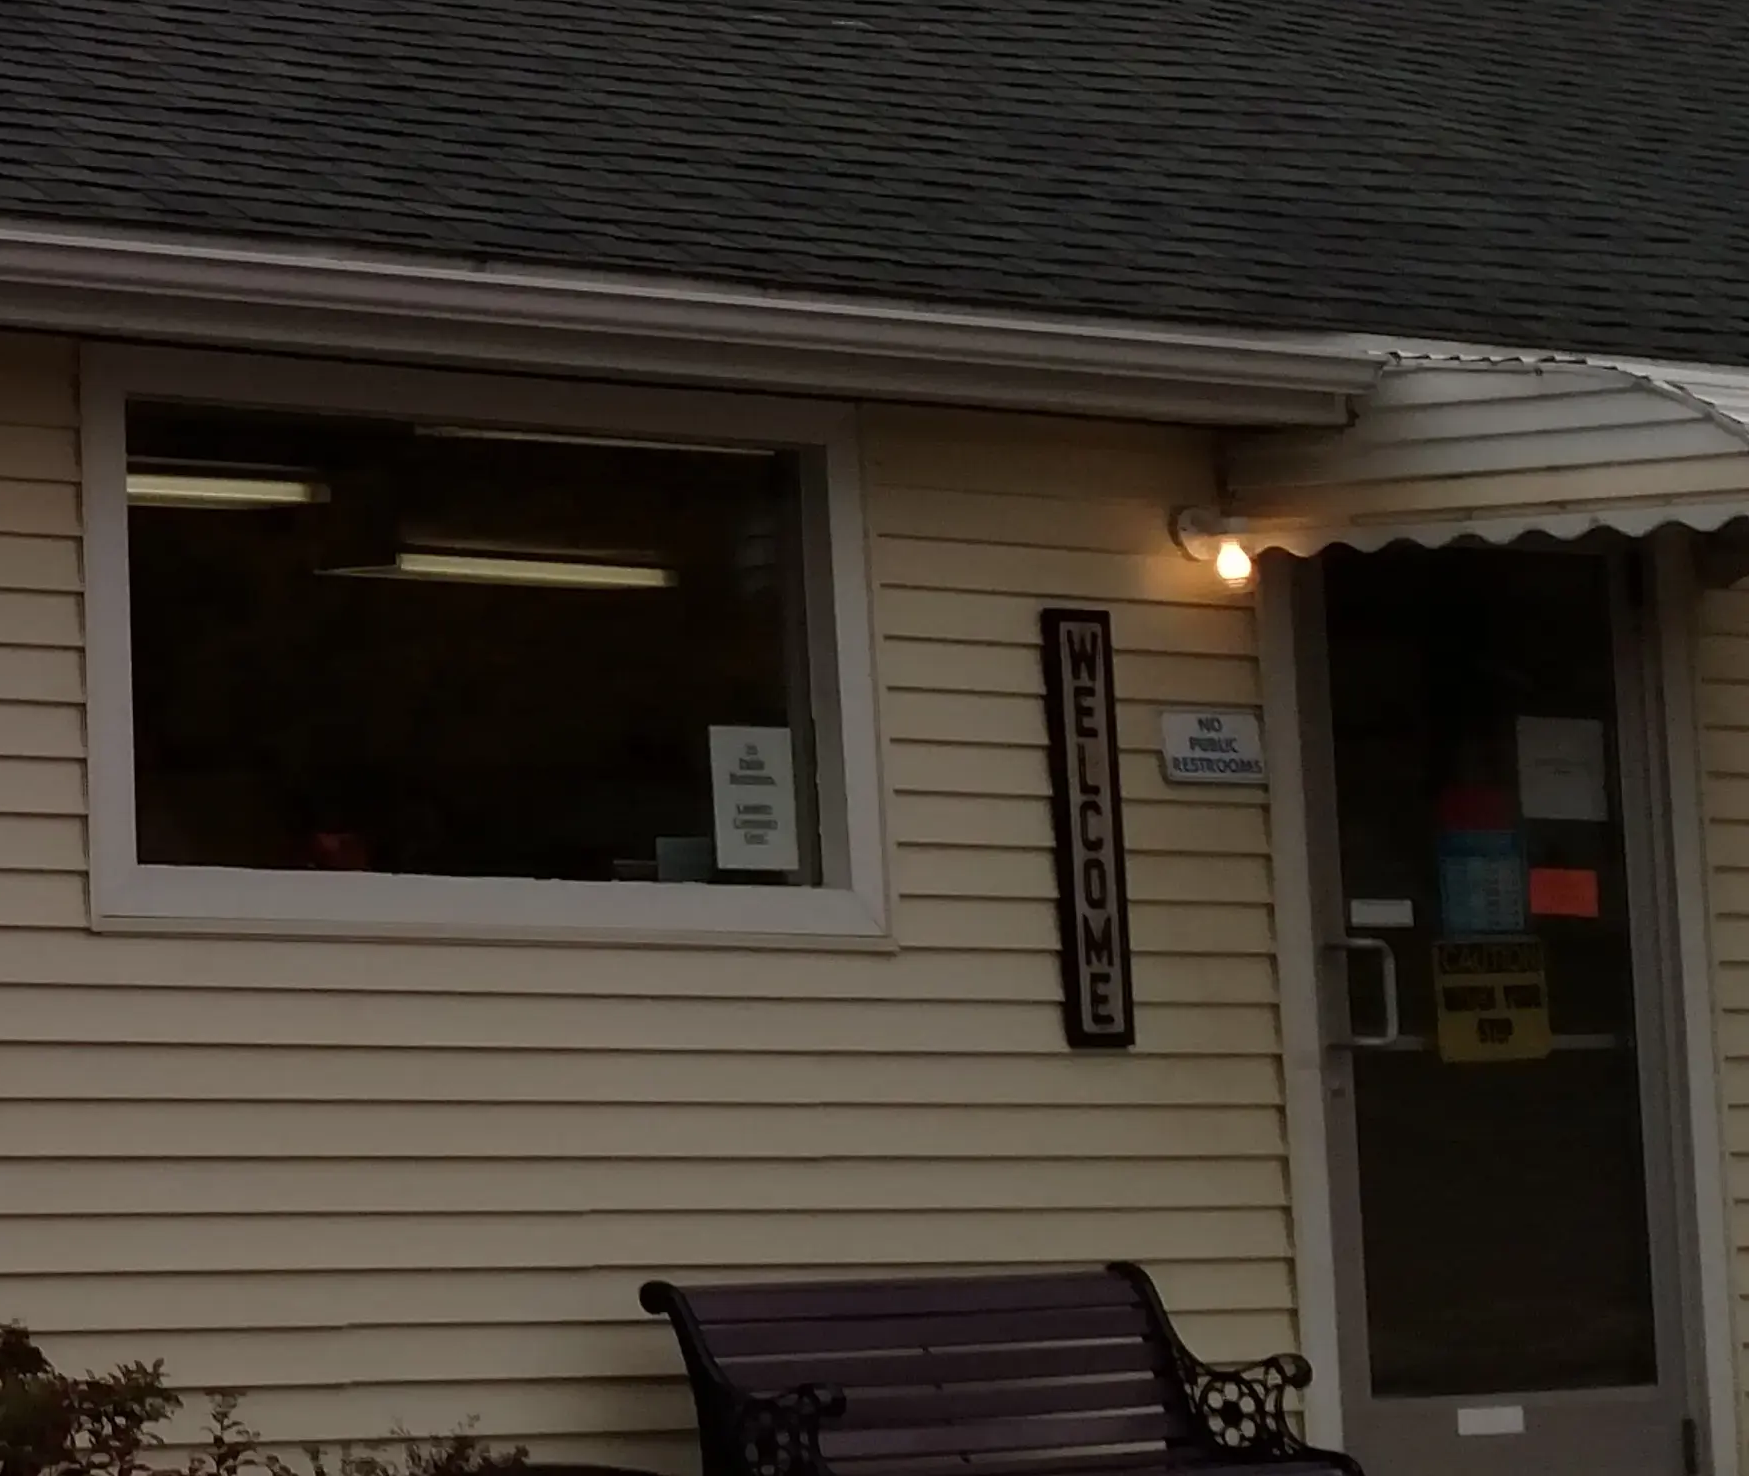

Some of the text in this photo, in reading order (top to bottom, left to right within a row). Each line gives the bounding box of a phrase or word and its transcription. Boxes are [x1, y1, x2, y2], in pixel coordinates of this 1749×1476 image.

[1198, 716, 1222, 733] NO
[1188, 736, 1239, 753] PUBLIC
[1172, 756, 1263, 773] RESTROOMS
[1066, 629, 1116, 1026] WELCOME
[1439, 944, 1543, 974] CAUTION
